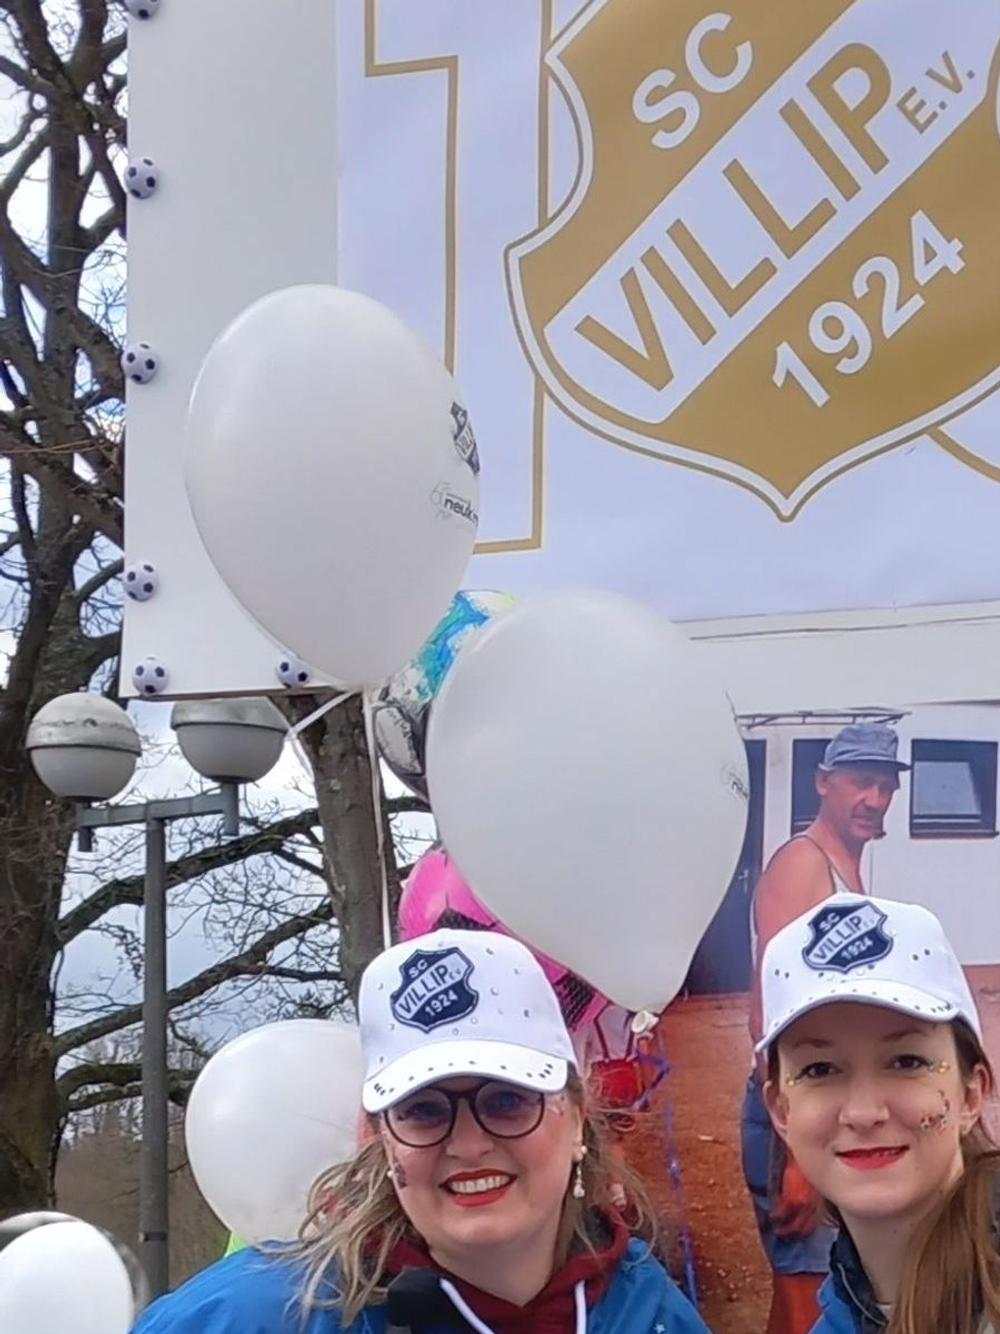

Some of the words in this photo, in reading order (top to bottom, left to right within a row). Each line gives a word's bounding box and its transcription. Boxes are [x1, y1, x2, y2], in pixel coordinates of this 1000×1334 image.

[631, 11, 754, 150] SC
[573, 42, 893, 392] VILLIP
[895, 51, 977, 135] E.V.
[771, 208, 968, 409] 1924
[812, 915, 863, 960] VILLIP
[841, 936, 874, 961] 1924
[398, 965, 449, 1014] VILLIP
[408, 959, 428, 979] SC
[425, 989, 459, 1017] 1924
